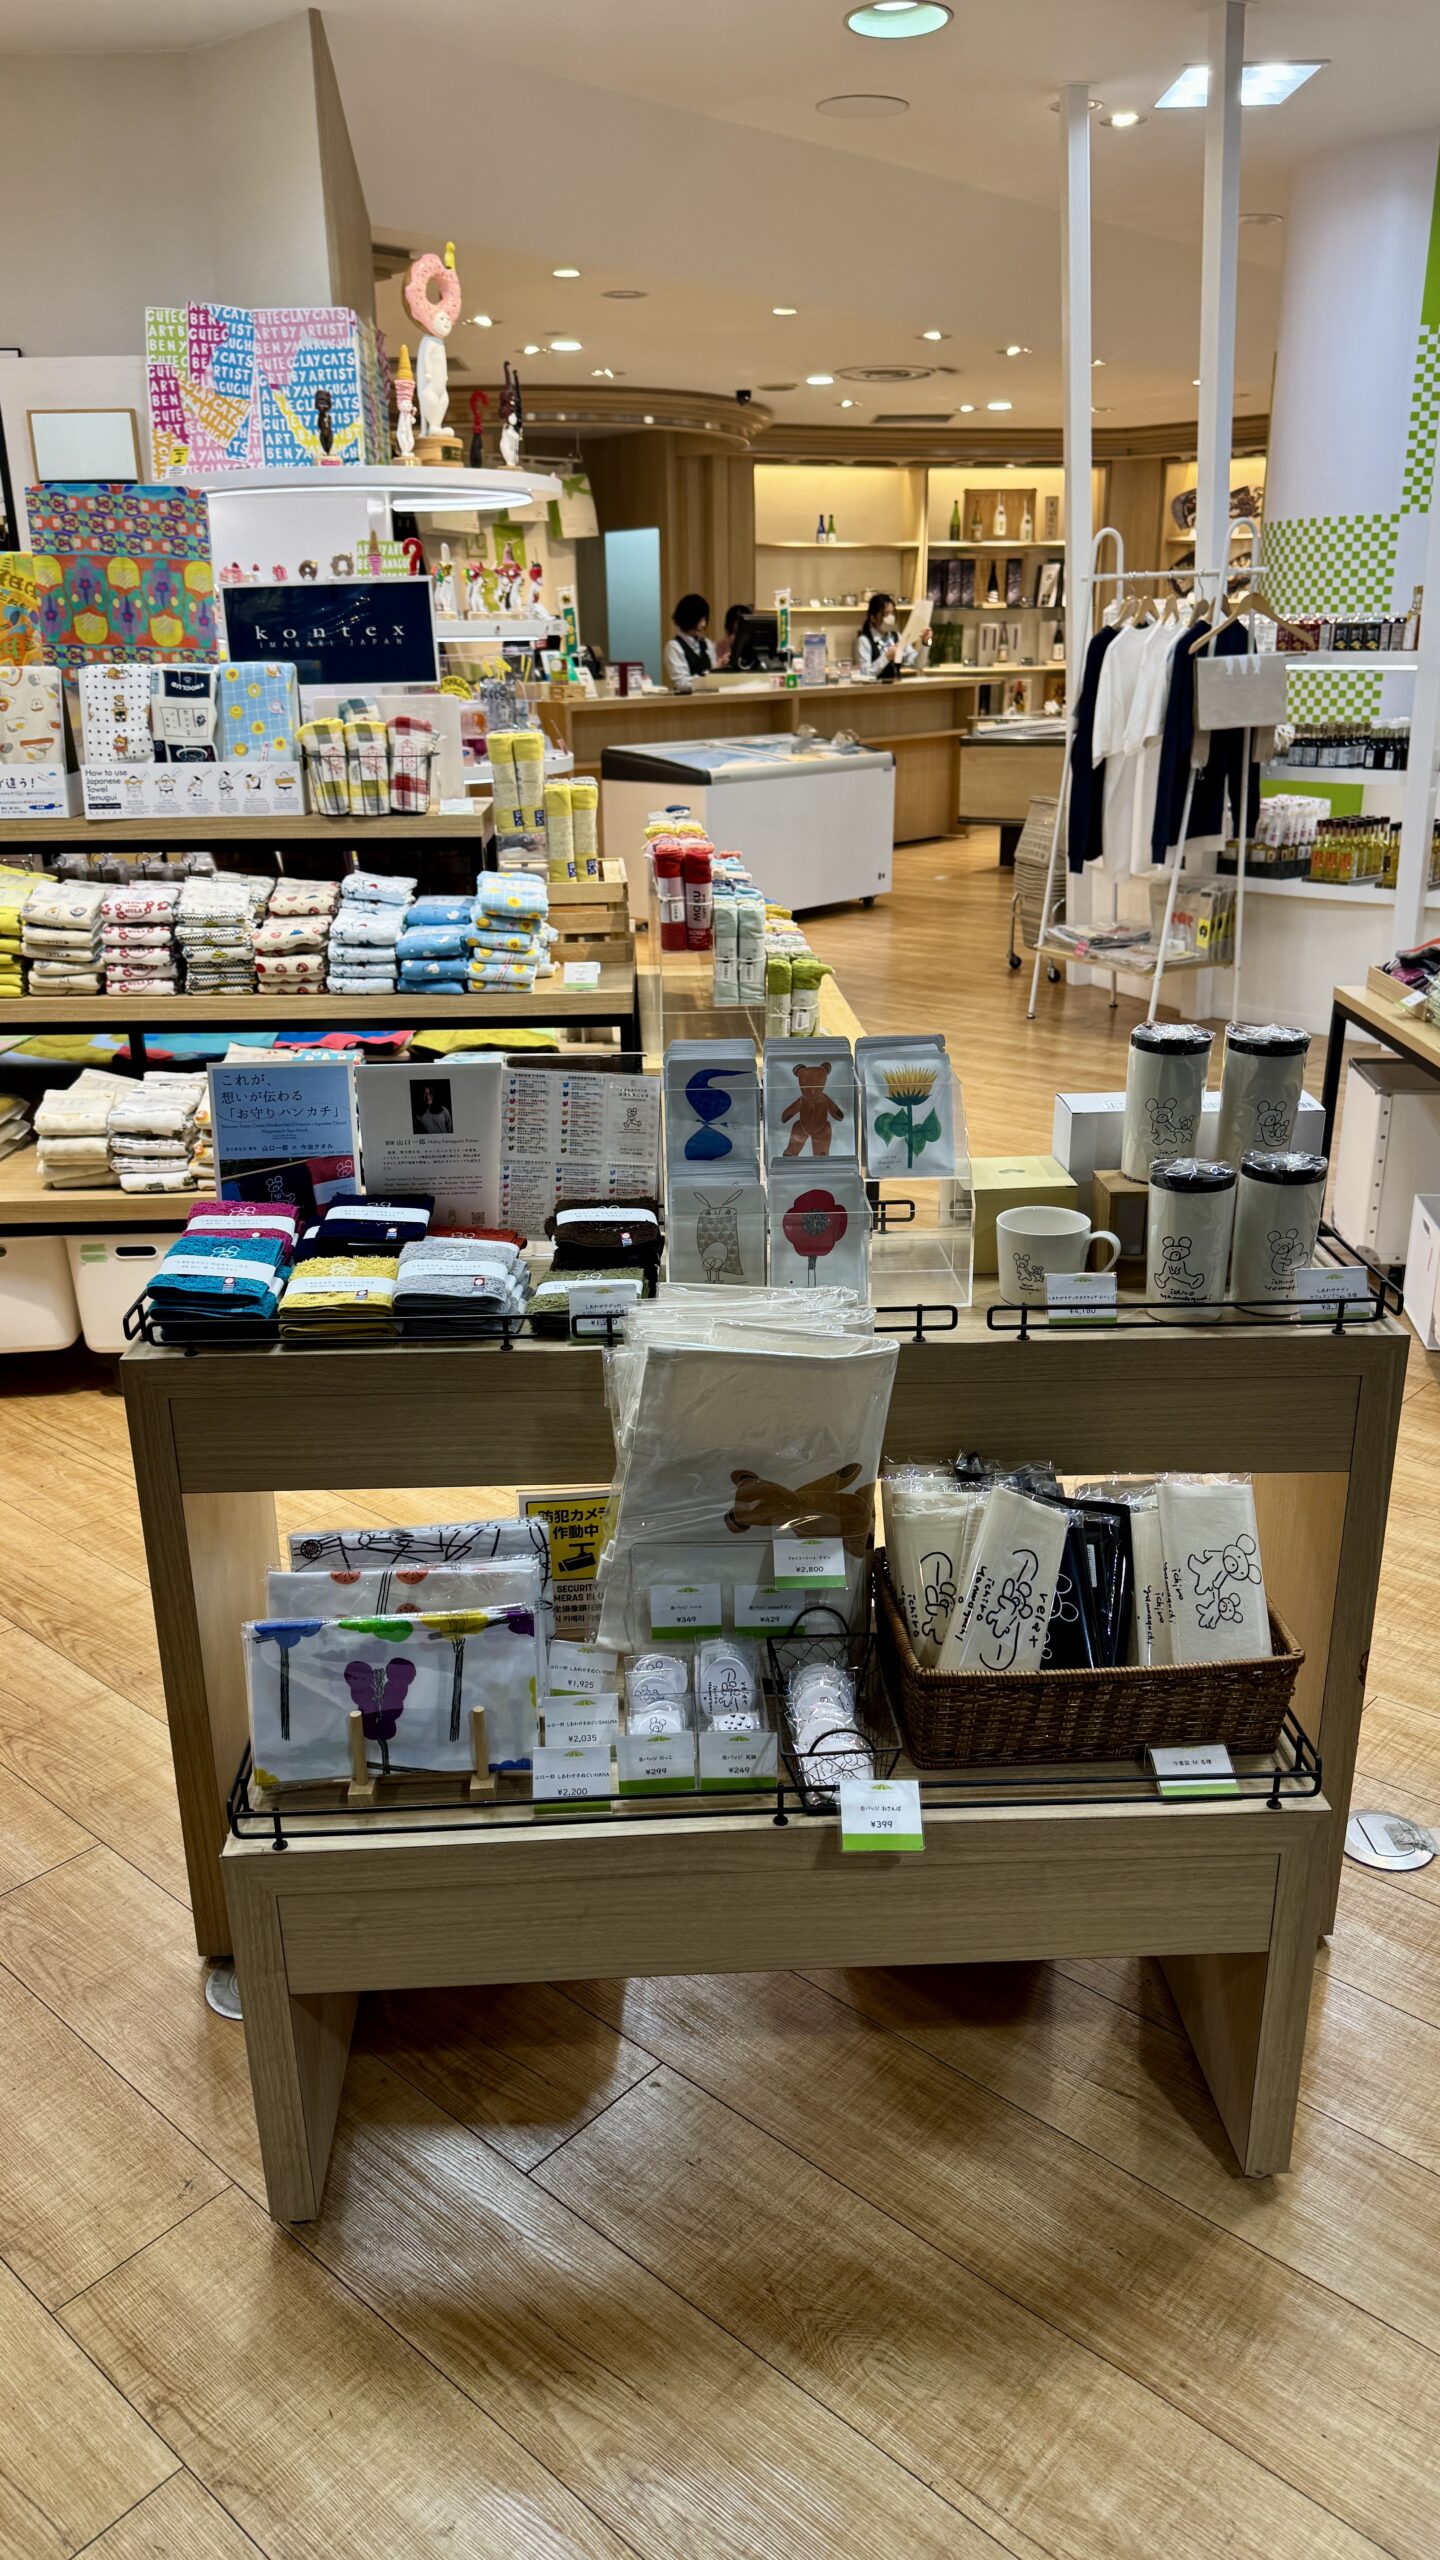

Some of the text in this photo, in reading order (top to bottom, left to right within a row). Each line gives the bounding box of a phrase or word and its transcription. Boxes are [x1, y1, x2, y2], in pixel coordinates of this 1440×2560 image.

[255, 625, 405, 640] kontex
[87, 793, 117, 802] Tenugui
[693, 890, 702, 922] MOKU
[222, 1073, 272, 1087] これが、
[221, 1089, 303, 1105] 想いが伝わる
[229, 1105, 340, 1120] 「お守りハンカチ」
[590, 1319, 618, 1327] ¥1,20
[553, 1524, 599, 1540] 作動中
[554, 1593, 584, 1602] MERAS
[975, 1577, 996, 1622] ichiro
[906, 1594, 920, 1638] ichiro
[568, 1679, 595, 1689] ¥1,925
[568, 1734, 597, 1743] ¥2,035
[645, 1767, 667, 1775] ¥299
[557, 1787, 588, 1796] ¥2,200
[870, 1820, 893, 1829] ¥399
